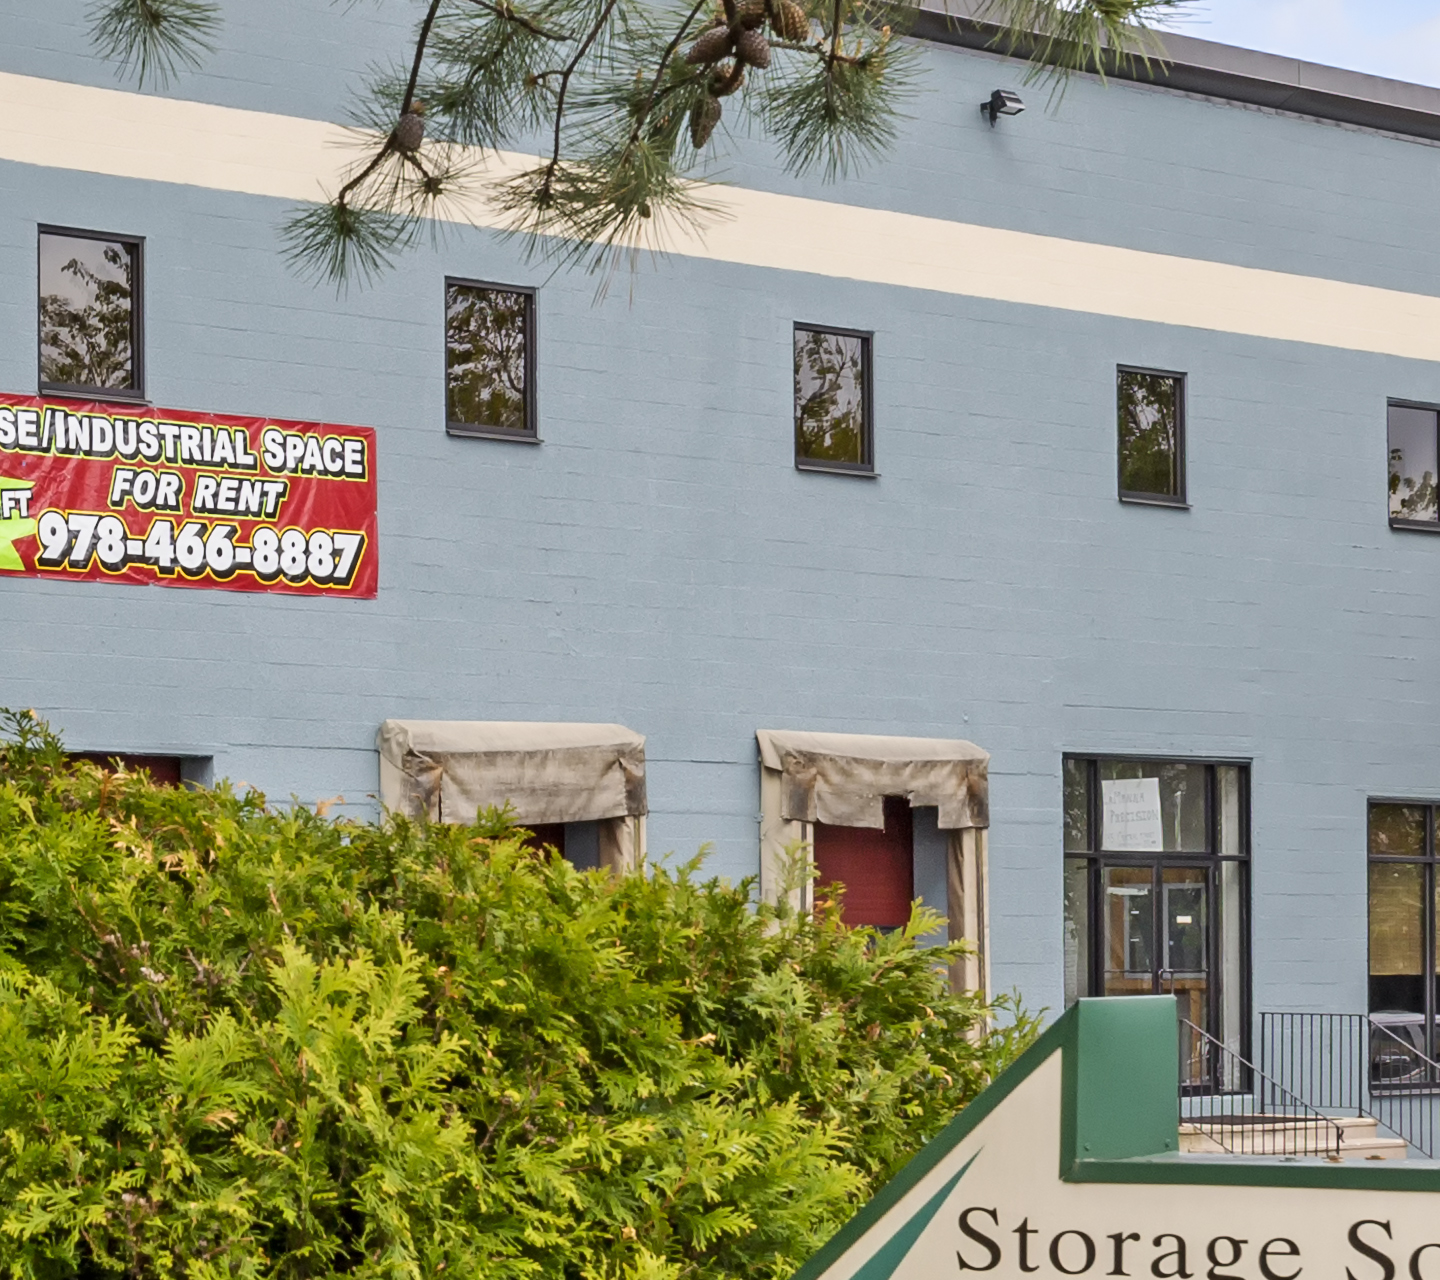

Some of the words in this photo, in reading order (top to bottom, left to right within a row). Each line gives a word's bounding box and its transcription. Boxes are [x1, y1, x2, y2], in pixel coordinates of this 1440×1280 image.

[263, 428, 365, 476] SPACE
[110, 468, 181, 508] FOR
[194, 476, 287, 515] RENT
[37, 510, 363, 580] 978-466-8887
